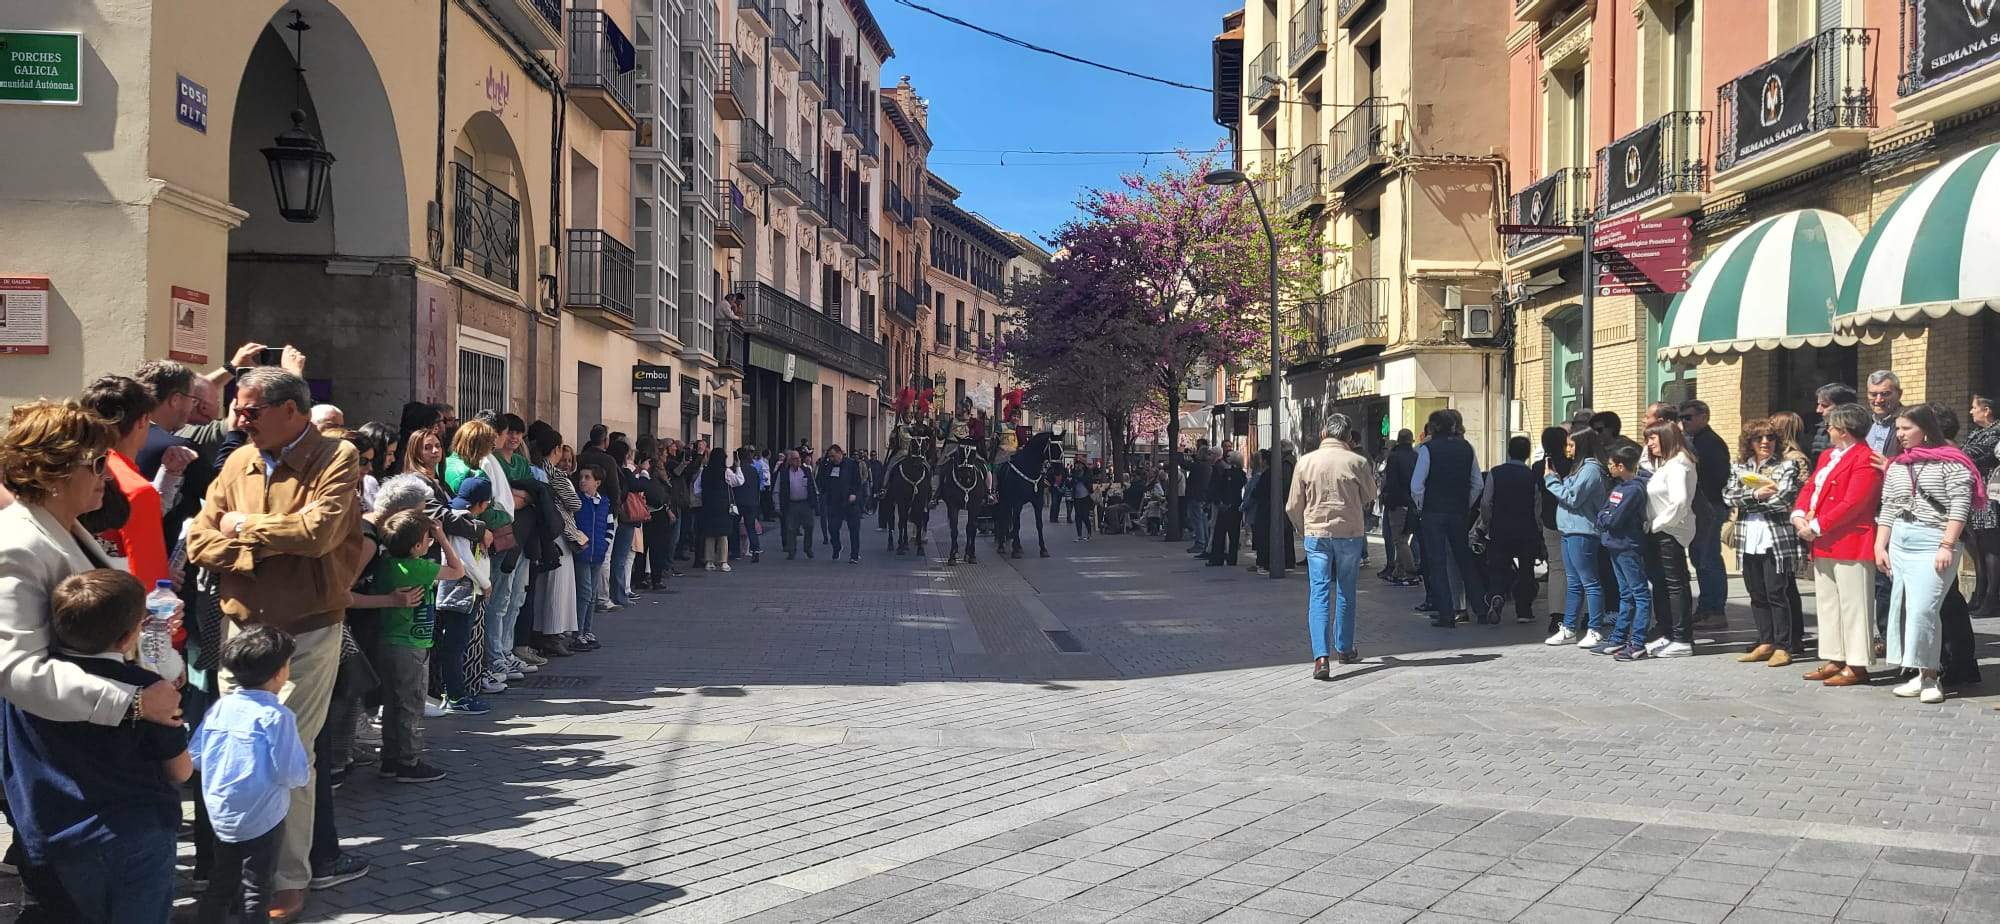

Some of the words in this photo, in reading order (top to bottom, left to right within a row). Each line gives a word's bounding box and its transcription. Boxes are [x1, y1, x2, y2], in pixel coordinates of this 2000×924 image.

[11, 51, 62, 63] PORCHES
[1931, 38, 1988, 70] SEMANA
[14, 65, 59, 76] GALICIA
[35, 80, 74, 90] Autónoma
[181, 83, 207, 106] COSO
[180, 103, 207, 126] ALTO
[1740, 136, 1774, 156] SEMANA
[1776, 122, 1803, 141] SANTA
[1610, 198, 1635, 211] SEMANA
[1636, 186, 1655, 201] SANTA
[1649, 237, 1676, 245] Provincial
[635, 369, 668, 380] embou
